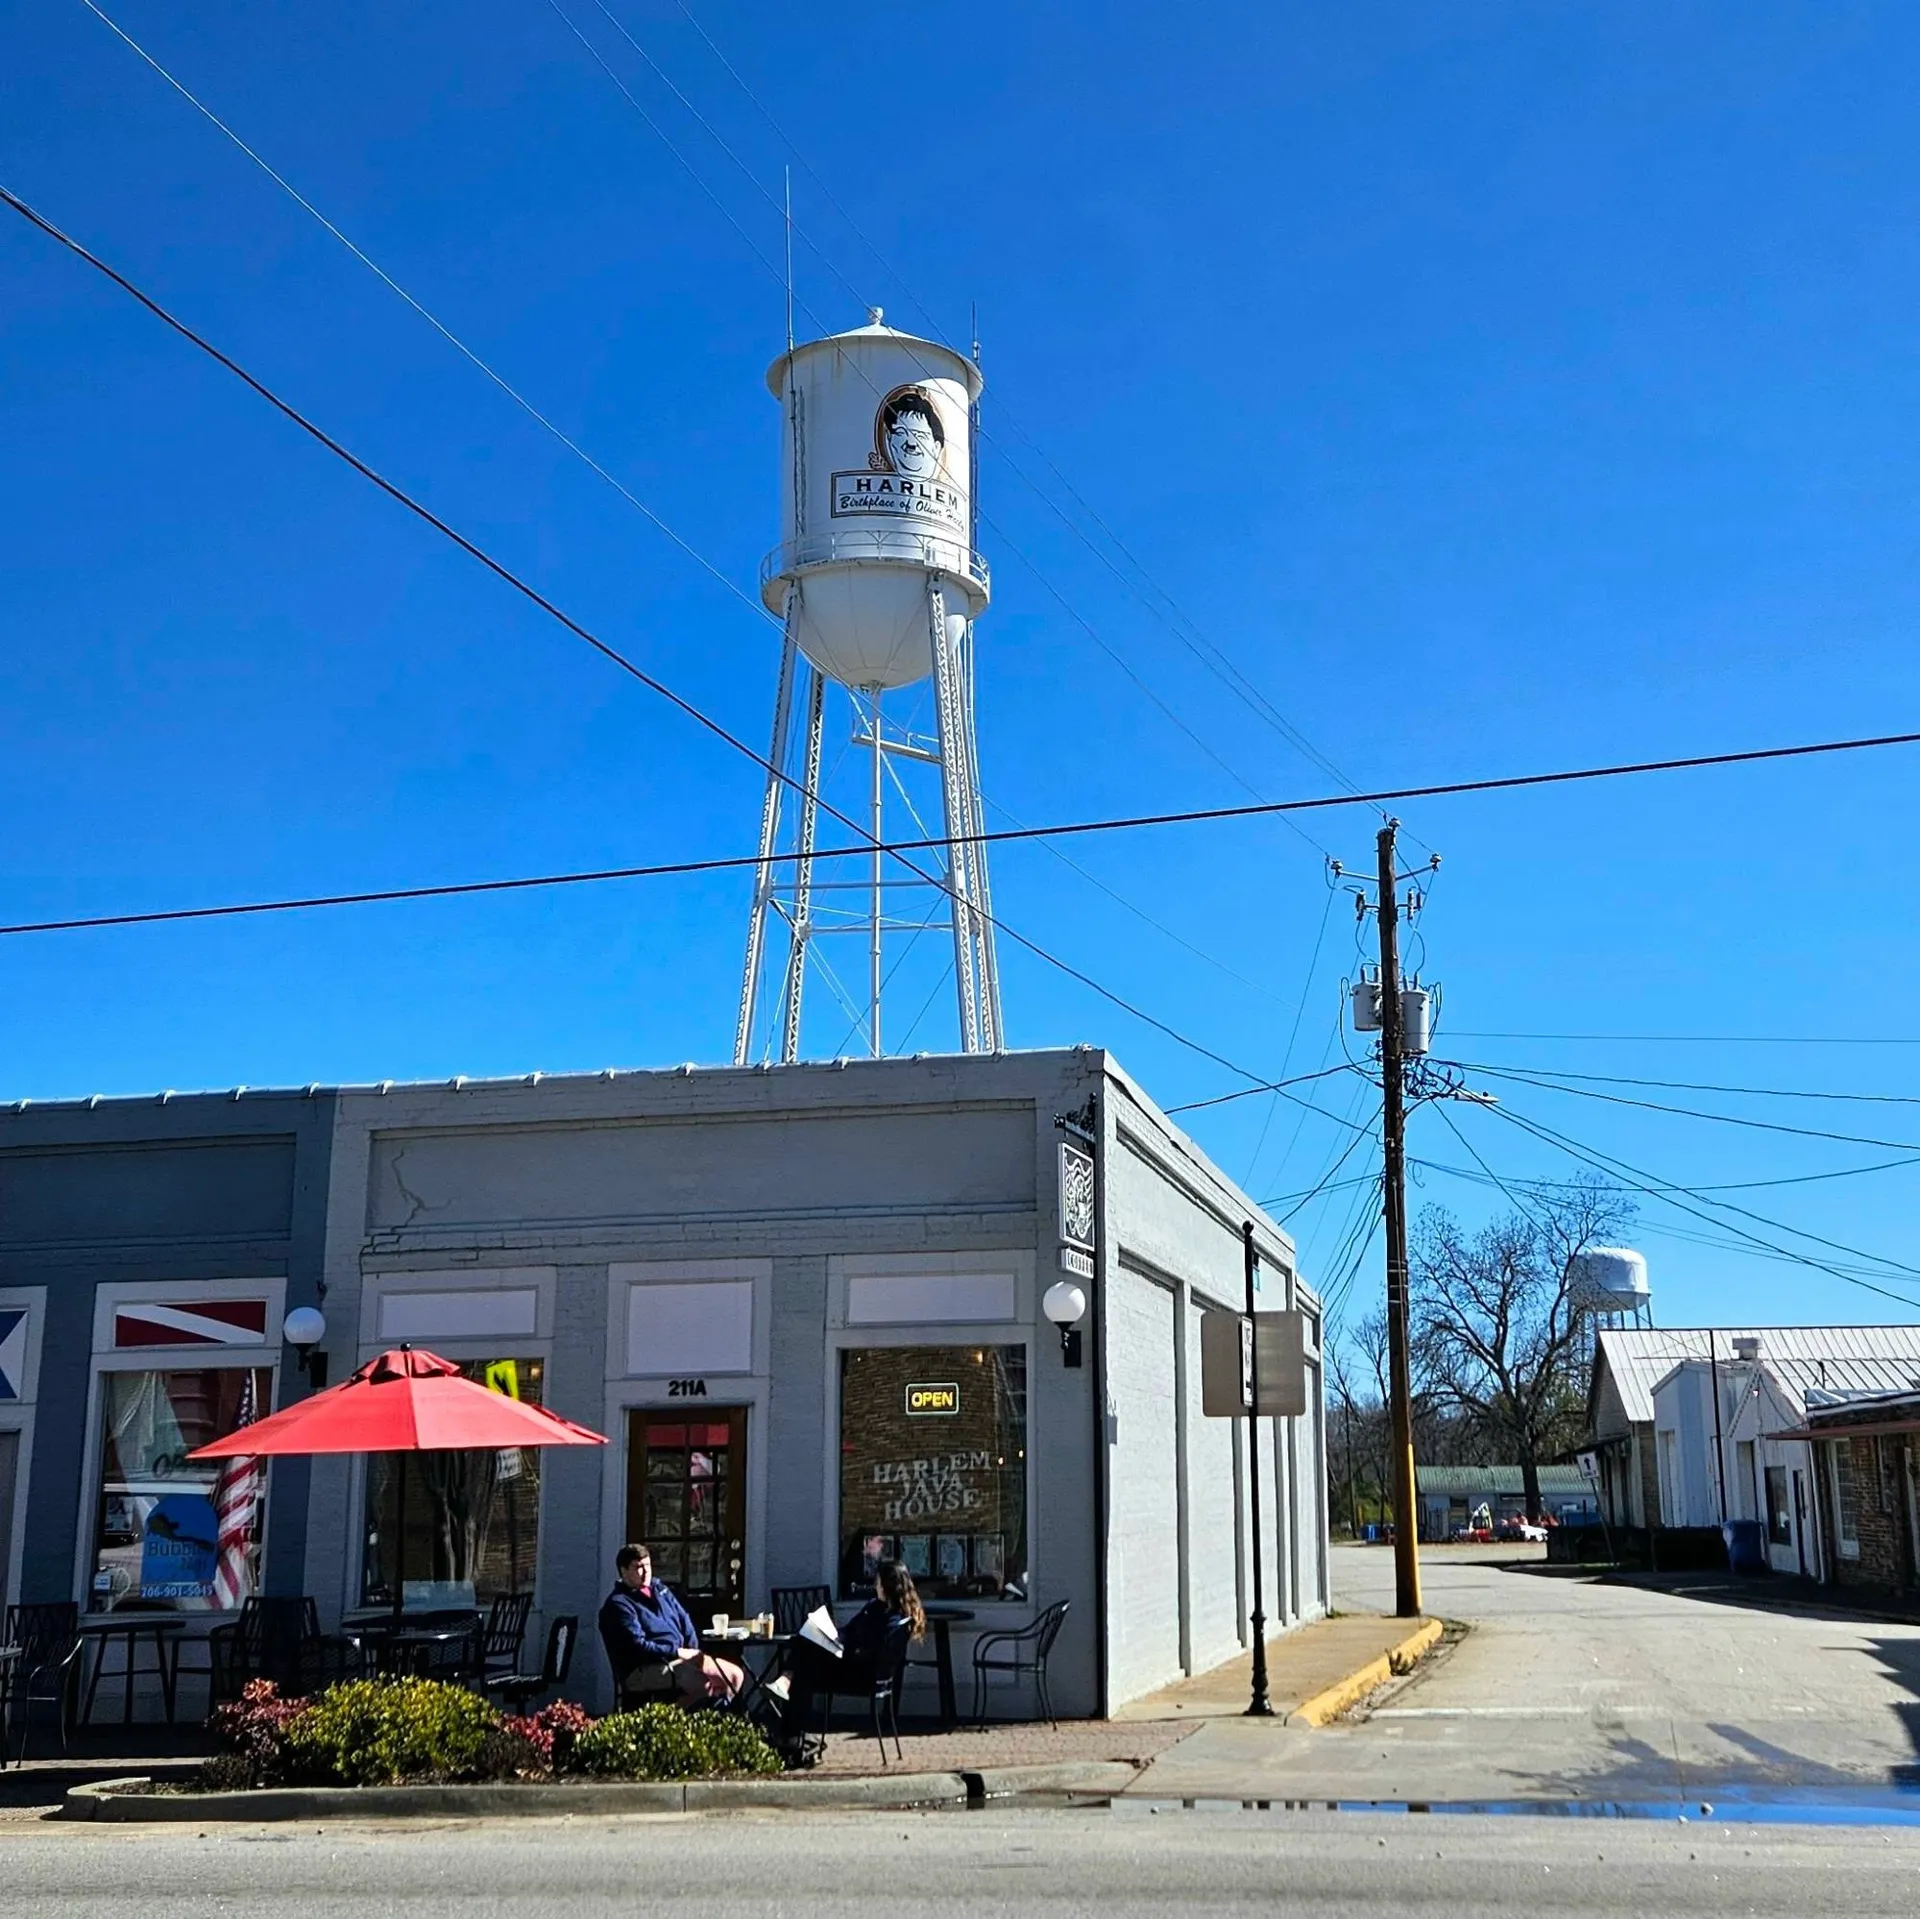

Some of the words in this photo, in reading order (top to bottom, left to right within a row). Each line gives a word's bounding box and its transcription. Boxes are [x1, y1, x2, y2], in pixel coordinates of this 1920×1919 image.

[840, 496, 895, 512] Birthplace
[899, 498, 911, 513] of
[856, 478, 958, 510] HARLEM
[668, 1380, 707, 1396] 211A
[911, 1392, 953, 1407] OPEN
[873, 1451, 992, 1484] HARLEM
[901, 1465, 965, 1500] JAVA
[884, 1488, 981, 1521] HOUSE
